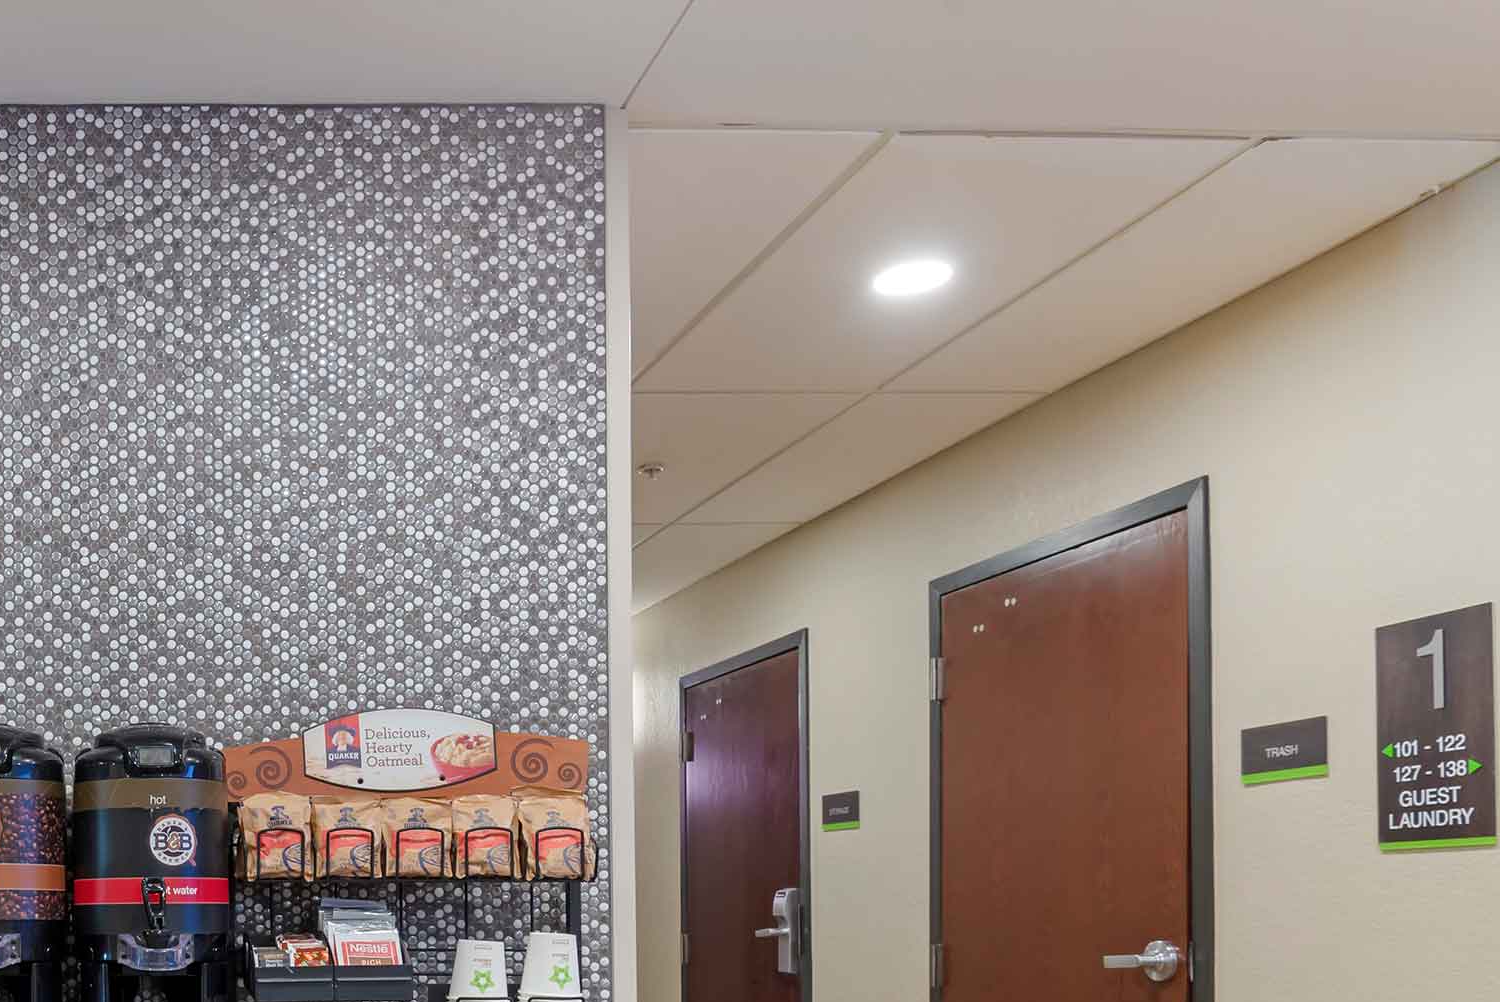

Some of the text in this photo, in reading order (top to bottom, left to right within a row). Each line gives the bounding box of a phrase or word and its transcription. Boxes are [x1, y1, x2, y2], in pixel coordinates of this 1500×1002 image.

[1416, 629, 1445, 709] 1
[365, 727, 431, 740] Delicious,
[366, 743, 413, 754] Hearty
[1265, 744, 1298, 759] TRASH
[1394, 740, 1419, 758] 101
[1436, 734, 1466, 752] 122
[328, 752, 360, 761] QUAKER
[366, 753, 423, 768] Oatmeal
[1393, 765, 1422, 782] 127
[1437, 760, 1467, 778] 138
[150, 794, 167, 805] hot
[1399, 786, 1461, 807] GUEST
[1389, 807, 1475, 830] LAUNDRY
[173, 886, 198, 895] water
